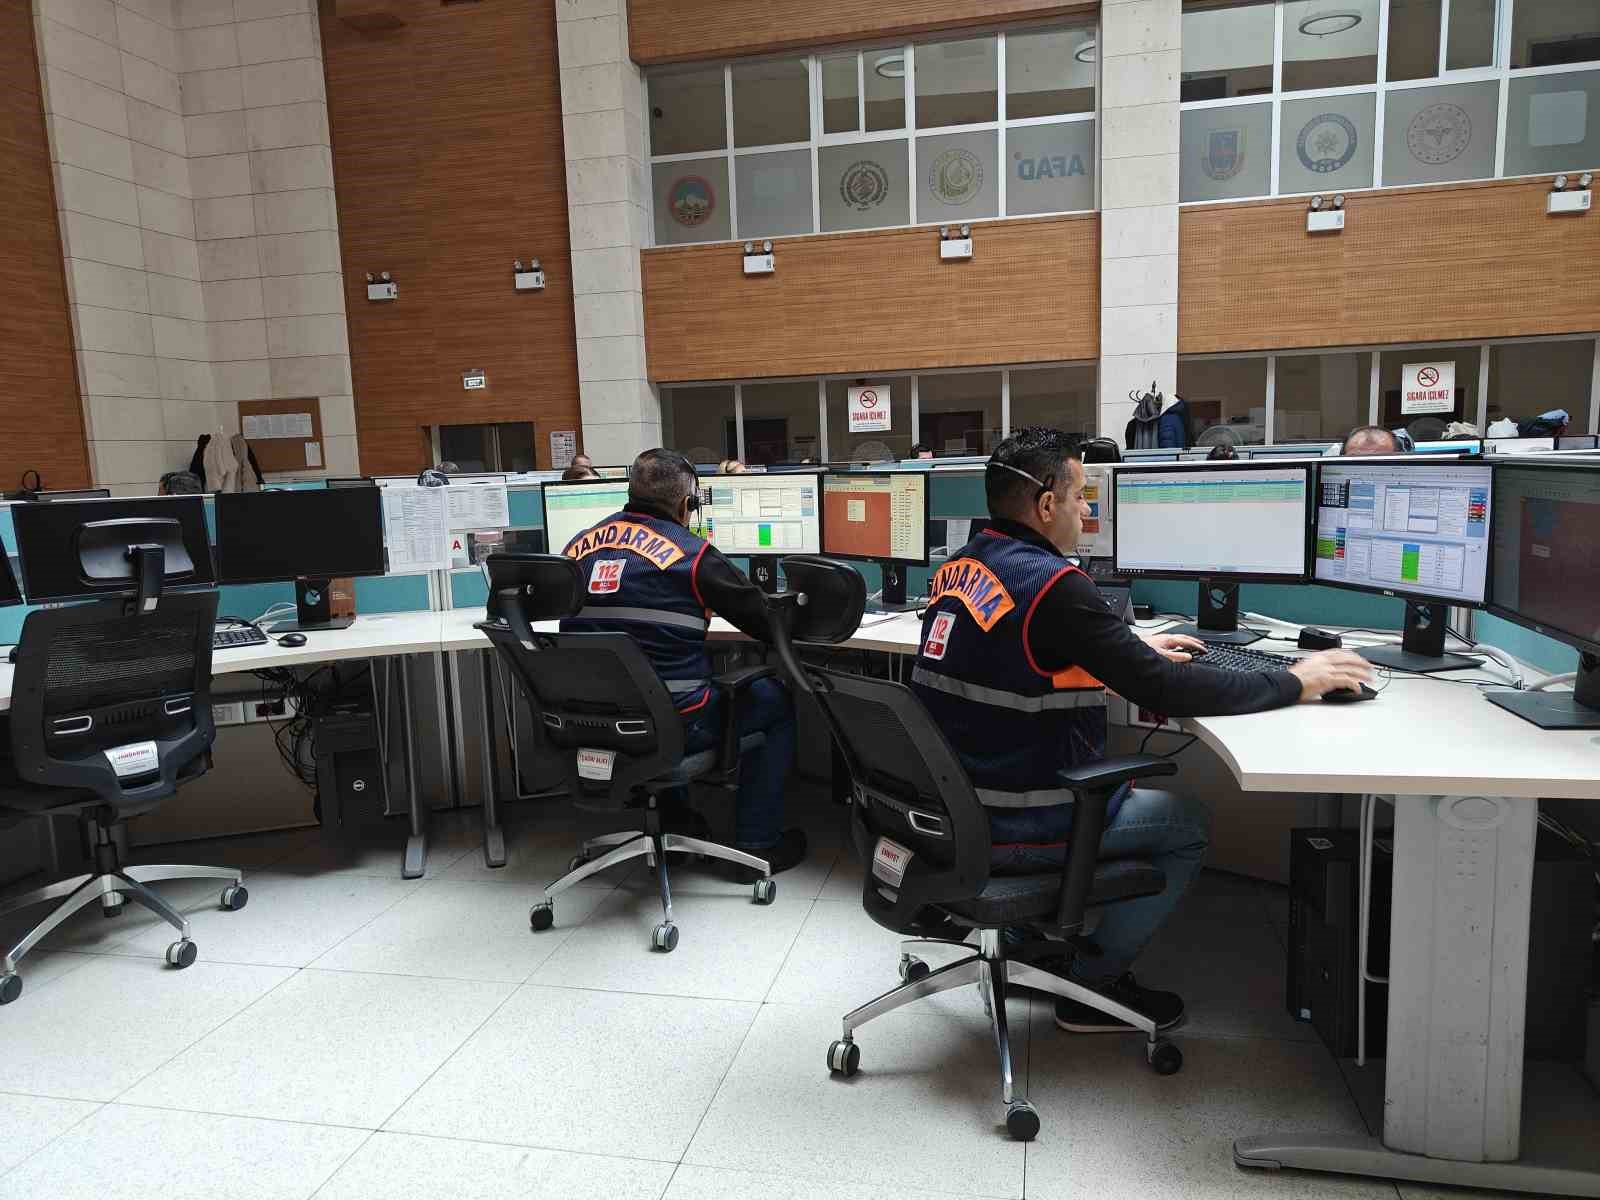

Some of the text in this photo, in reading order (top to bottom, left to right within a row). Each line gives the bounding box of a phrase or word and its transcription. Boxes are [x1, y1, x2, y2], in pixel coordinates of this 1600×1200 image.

[452, 540, 462, 550] A
[574, 525, 675, 565] JANDARMA
[598, 564, 620, 580] 112
[931, 563, 1004, 623] ANDARMA
[933, 618, 949, 641] 112
